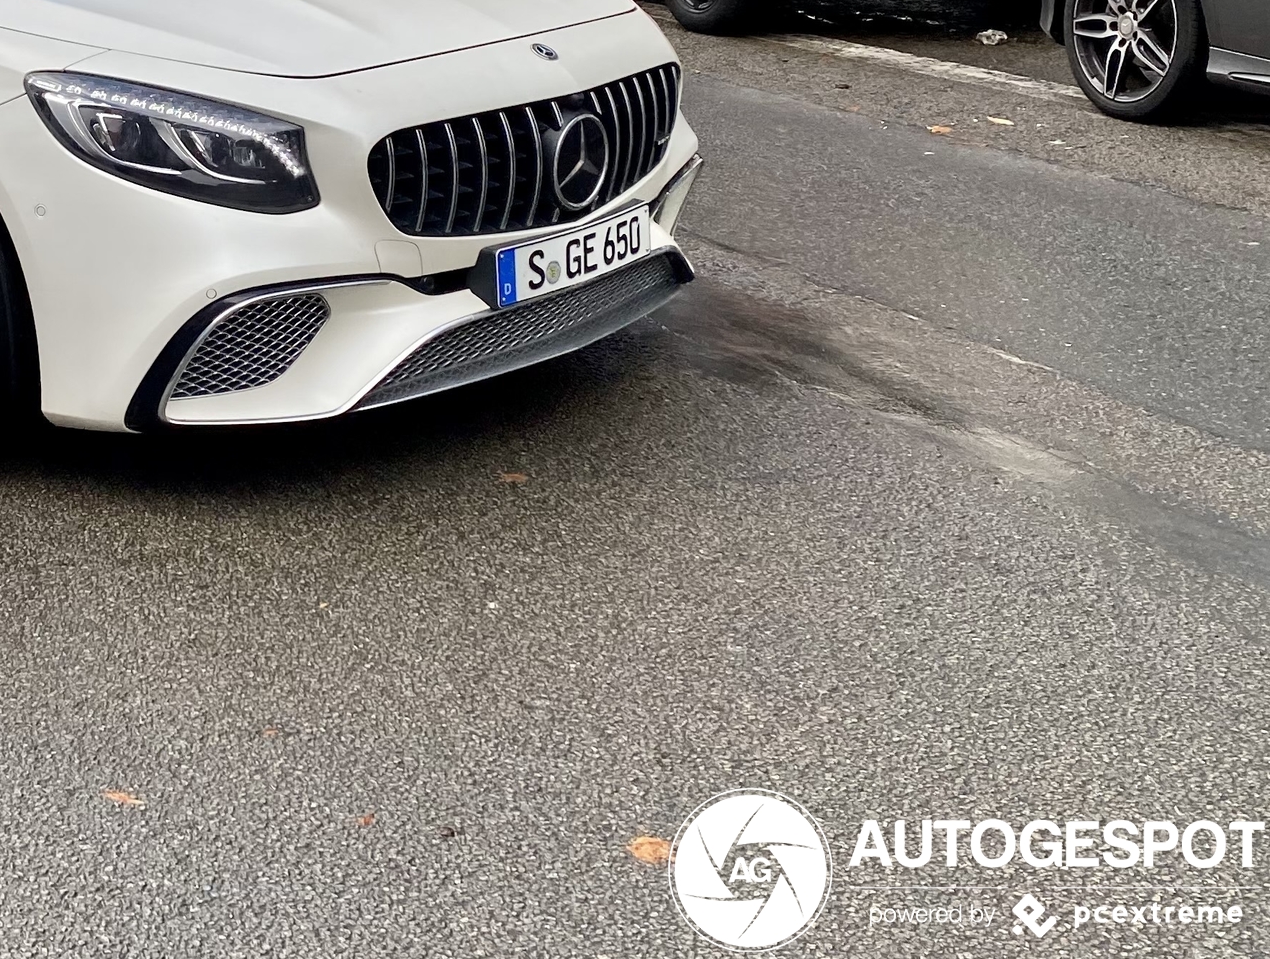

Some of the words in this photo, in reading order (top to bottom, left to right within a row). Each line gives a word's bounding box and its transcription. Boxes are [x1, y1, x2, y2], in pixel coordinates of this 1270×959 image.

[528, 249, 545, 290] S
[566, 232, 598, 279] GE
[603, 216, 641, 266] 650
[504, 282, 512, 295] D
